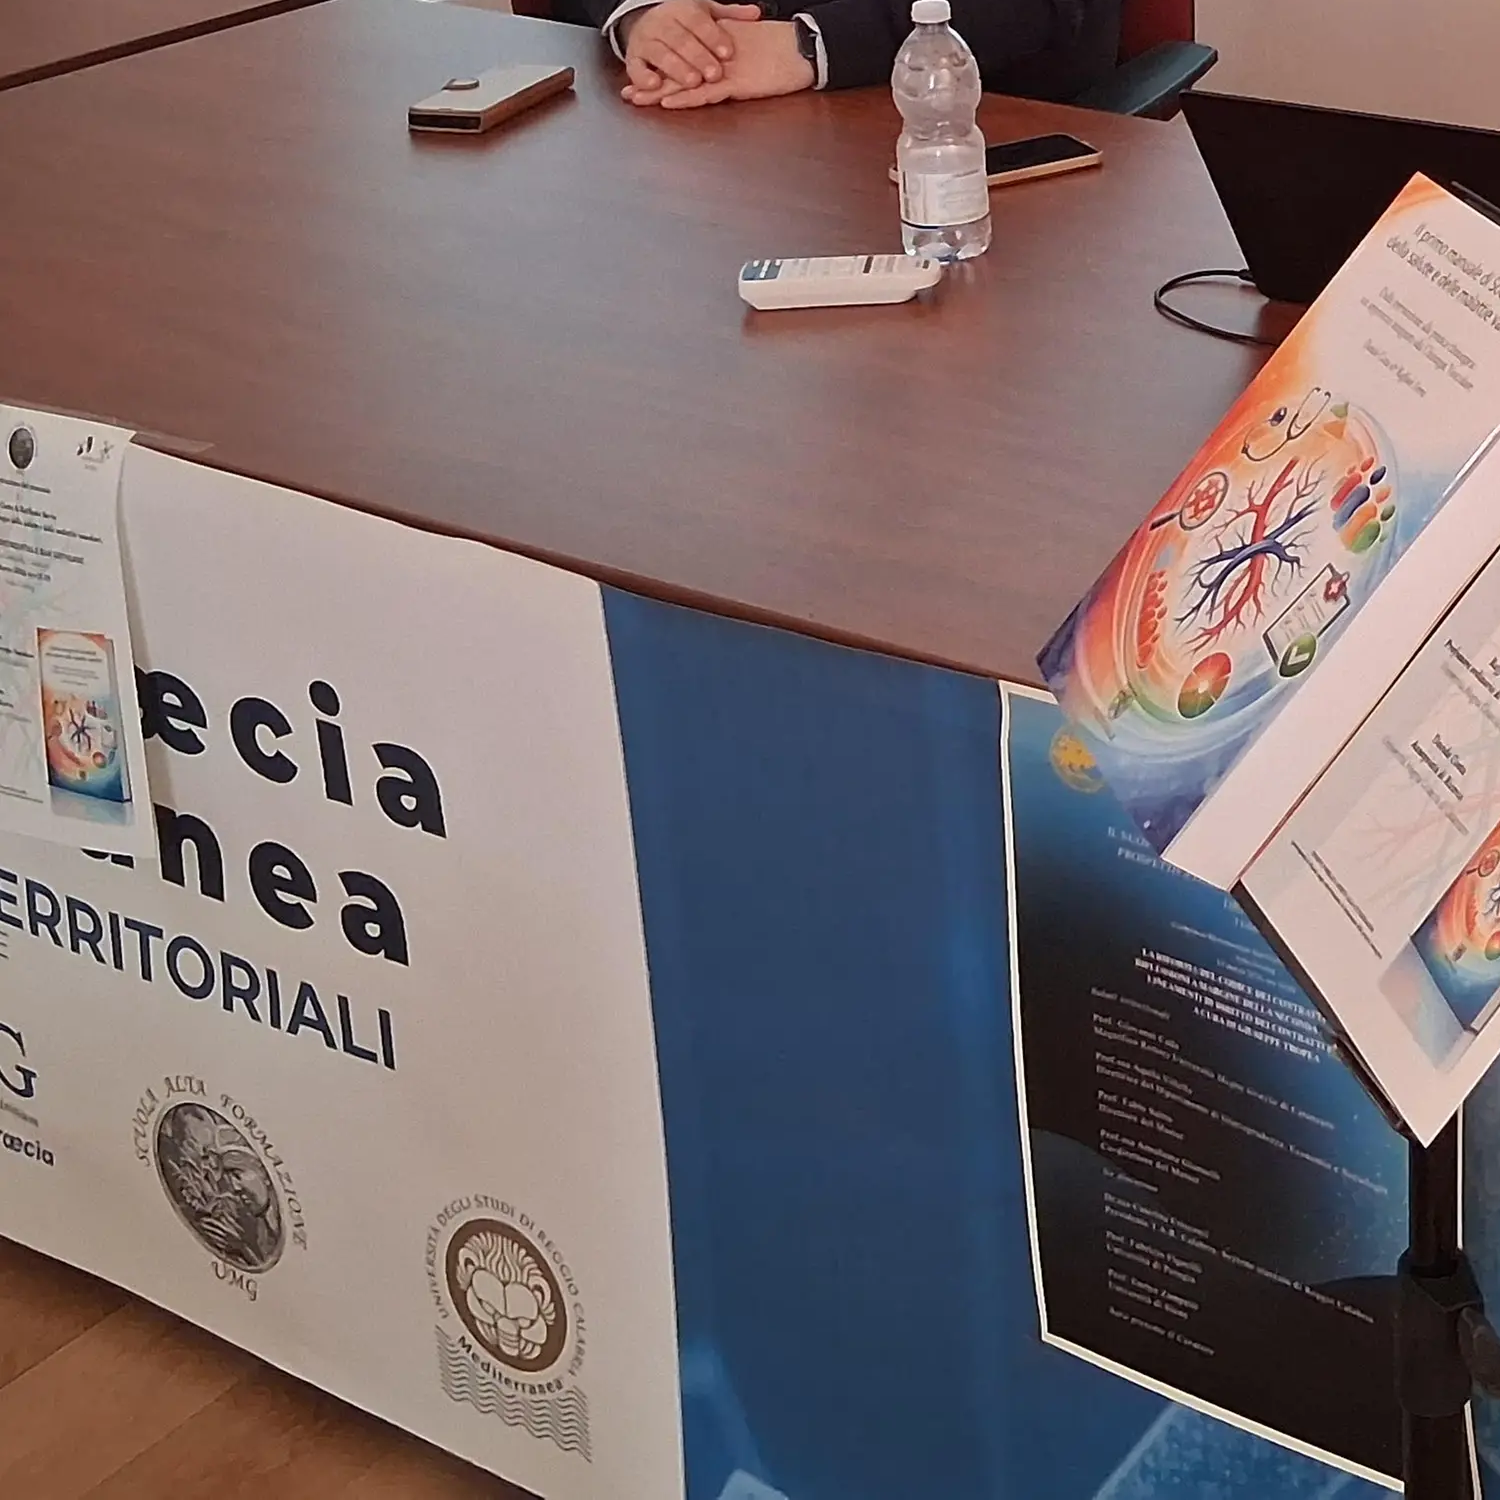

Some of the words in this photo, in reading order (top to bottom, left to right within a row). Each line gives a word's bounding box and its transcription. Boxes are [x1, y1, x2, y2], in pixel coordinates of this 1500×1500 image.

[1387, 237, 1409, 258] della
[1407, 252, 1434, 277] salute
[1437, 273, 1460, 297] delle
[1457, 290, 1493, 321] malattie
[1417, 231, 1449, 255] primo
[1446, 249, 1483, 280] manuale
[0, 869, 397, 1071] ERRITORIALI
[473, 1193, 515, 1218] STUDI
[519, 1213, 536, 1231] DI
[536, 1230, 579, 1297] REGGIO
[457, 1334, 564, 1396] Mediterranea
